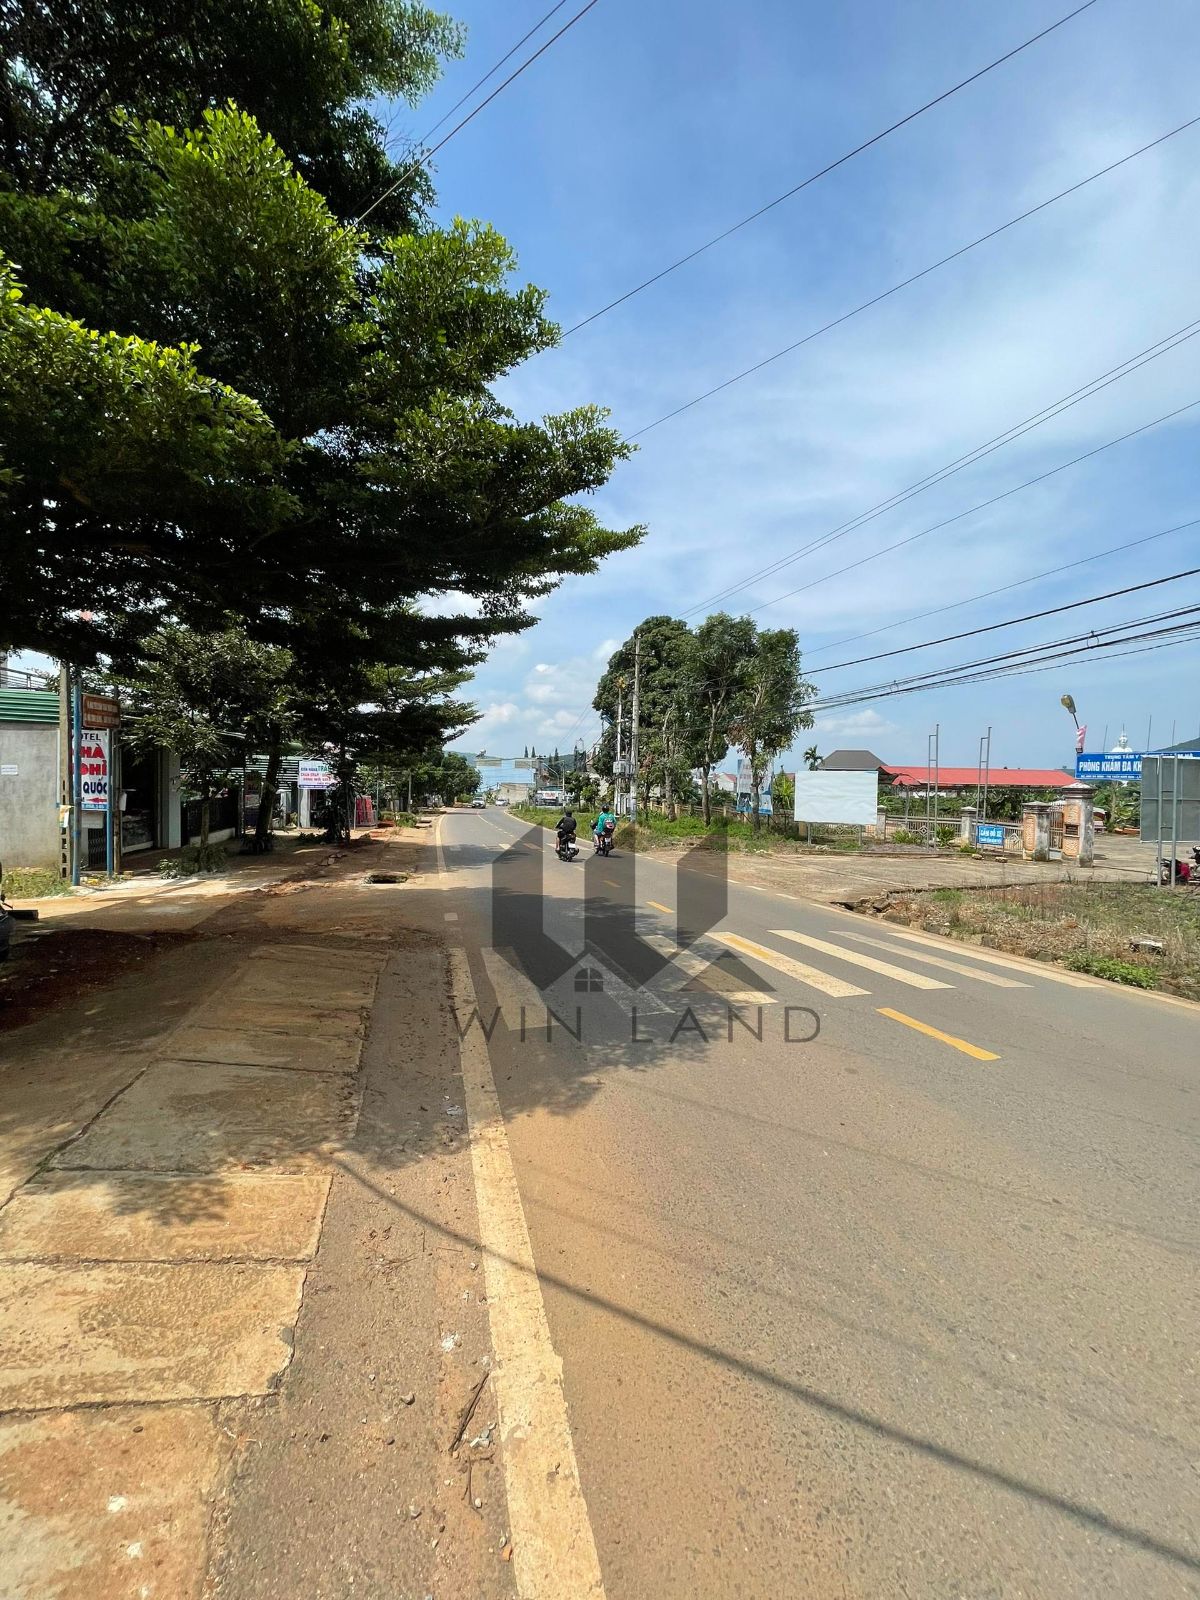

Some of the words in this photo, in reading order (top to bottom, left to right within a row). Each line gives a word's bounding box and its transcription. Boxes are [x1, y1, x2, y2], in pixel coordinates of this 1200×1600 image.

[1079, 759, 1100, 772] PHÒNG
[1101, 759, 1120, 772] KHÁM
[1122, 761, 1132, 772] ĐA
[1132, 761, 1142, 772] KH
